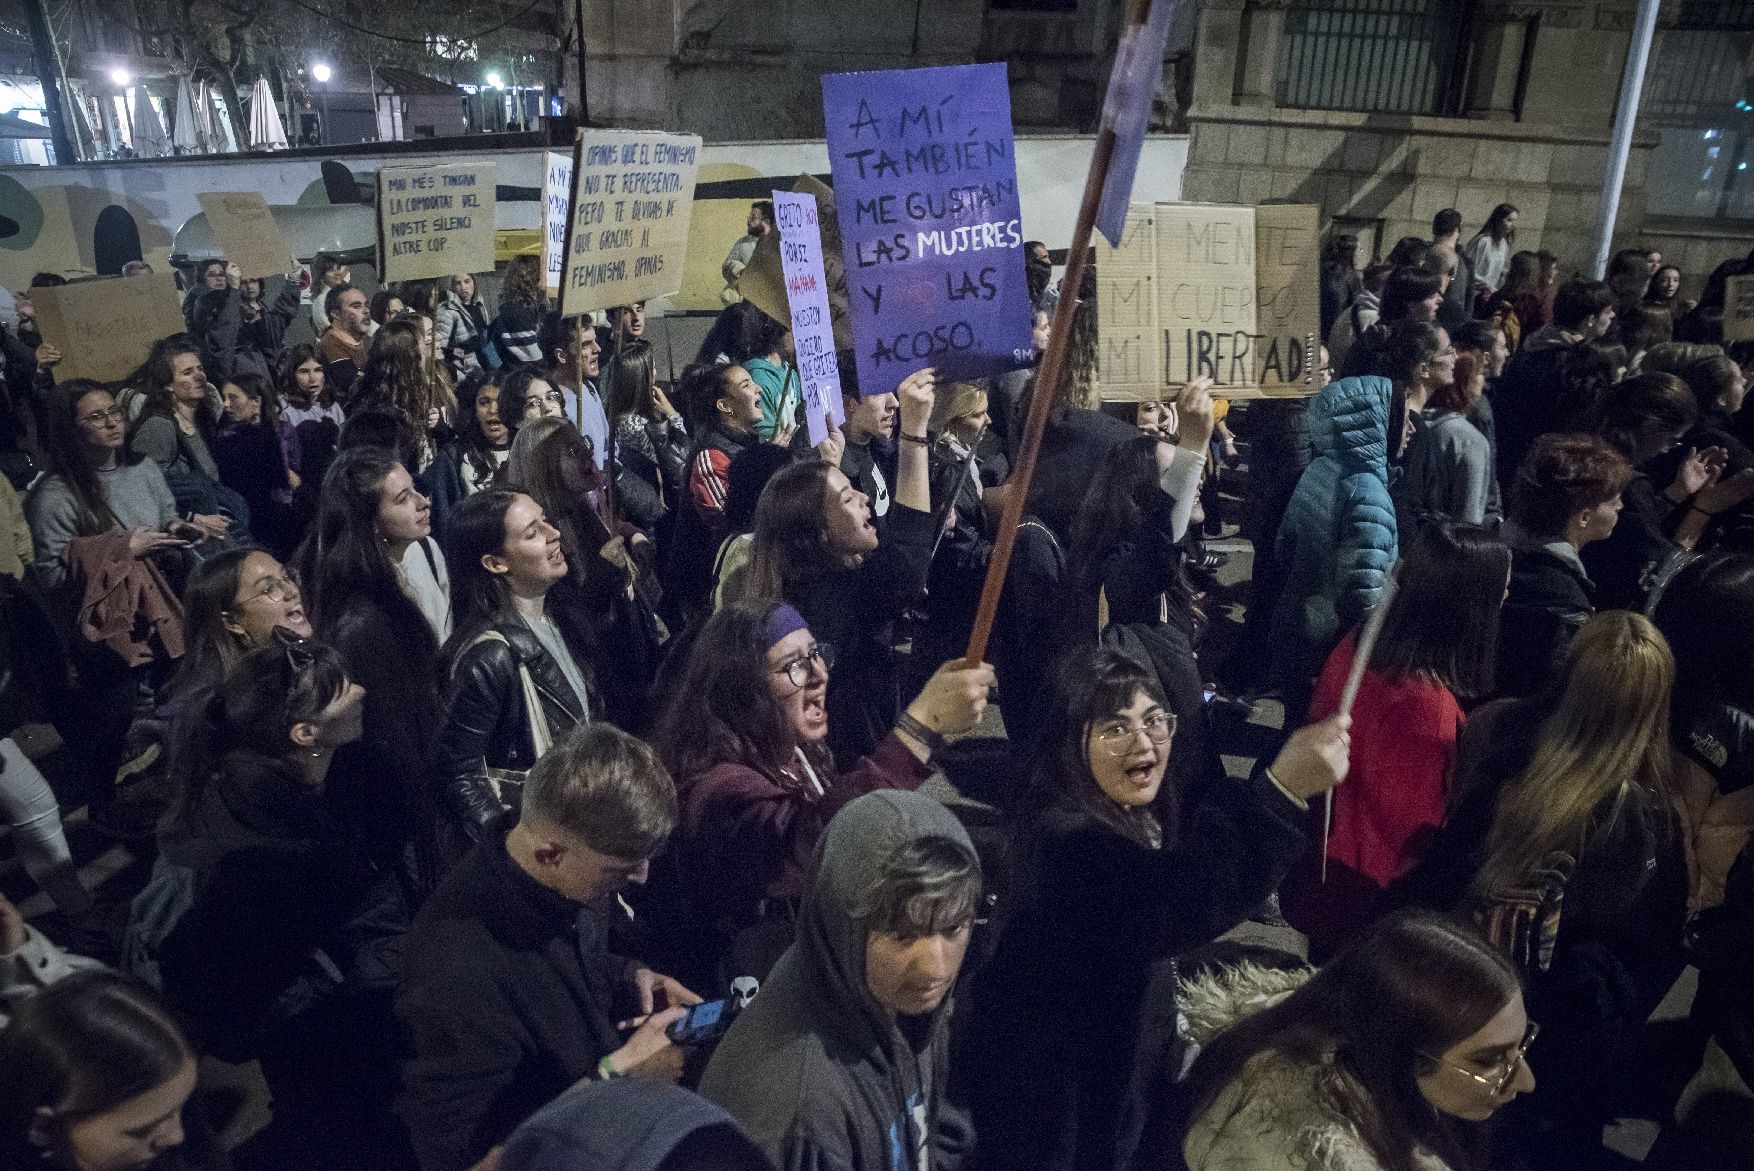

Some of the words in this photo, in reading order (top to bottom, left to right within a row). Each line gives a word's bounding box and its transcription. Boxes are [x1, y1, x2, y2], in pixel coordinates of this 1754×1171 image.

[848, 98, 880, 140] A
[899, 95, 954, 138] MÍ
[621, 143, 638, 166] QUE
[640, 143, 649, 165] EL
[654, 143, 696, 165] FEMINISMO
[845, 127, 1006, 180] TAMBIÉN
[411, 173, 435, 190] MÉS
[549, 167, 556, 186] A
[584, 174, 600, 195] NO
[605, 174, 617, 194] TE
[389, 198, 403, 215] LA
[578, 200, 605, 225] PERO
[614, 200, 626, 222] TE
[632, 199, 662, 220] OLVIDAS
[778, 202, 802, 229] GRITO
[855, 195, 897, 225] ME
[905, 178, 1014, 220] GUSTAN
[392, 239, 422, 256] ALTRE
[574, 231, 593, 255] QUE
[599, 227, 633, 250] GRACIAS
[641, 226, 650, 249] AL
[855, 233, 911, 268] LAS
[917, 218, 1021, 259] MUJERES
[1185, 221, 1309, 266] MENTE
[862, 284, 883, 316] Y
[946, 266, 998, 301] LAS
[1172, 282, 1297, 324] CUERPO
[870, 321, 983, 367] ACOSO.
